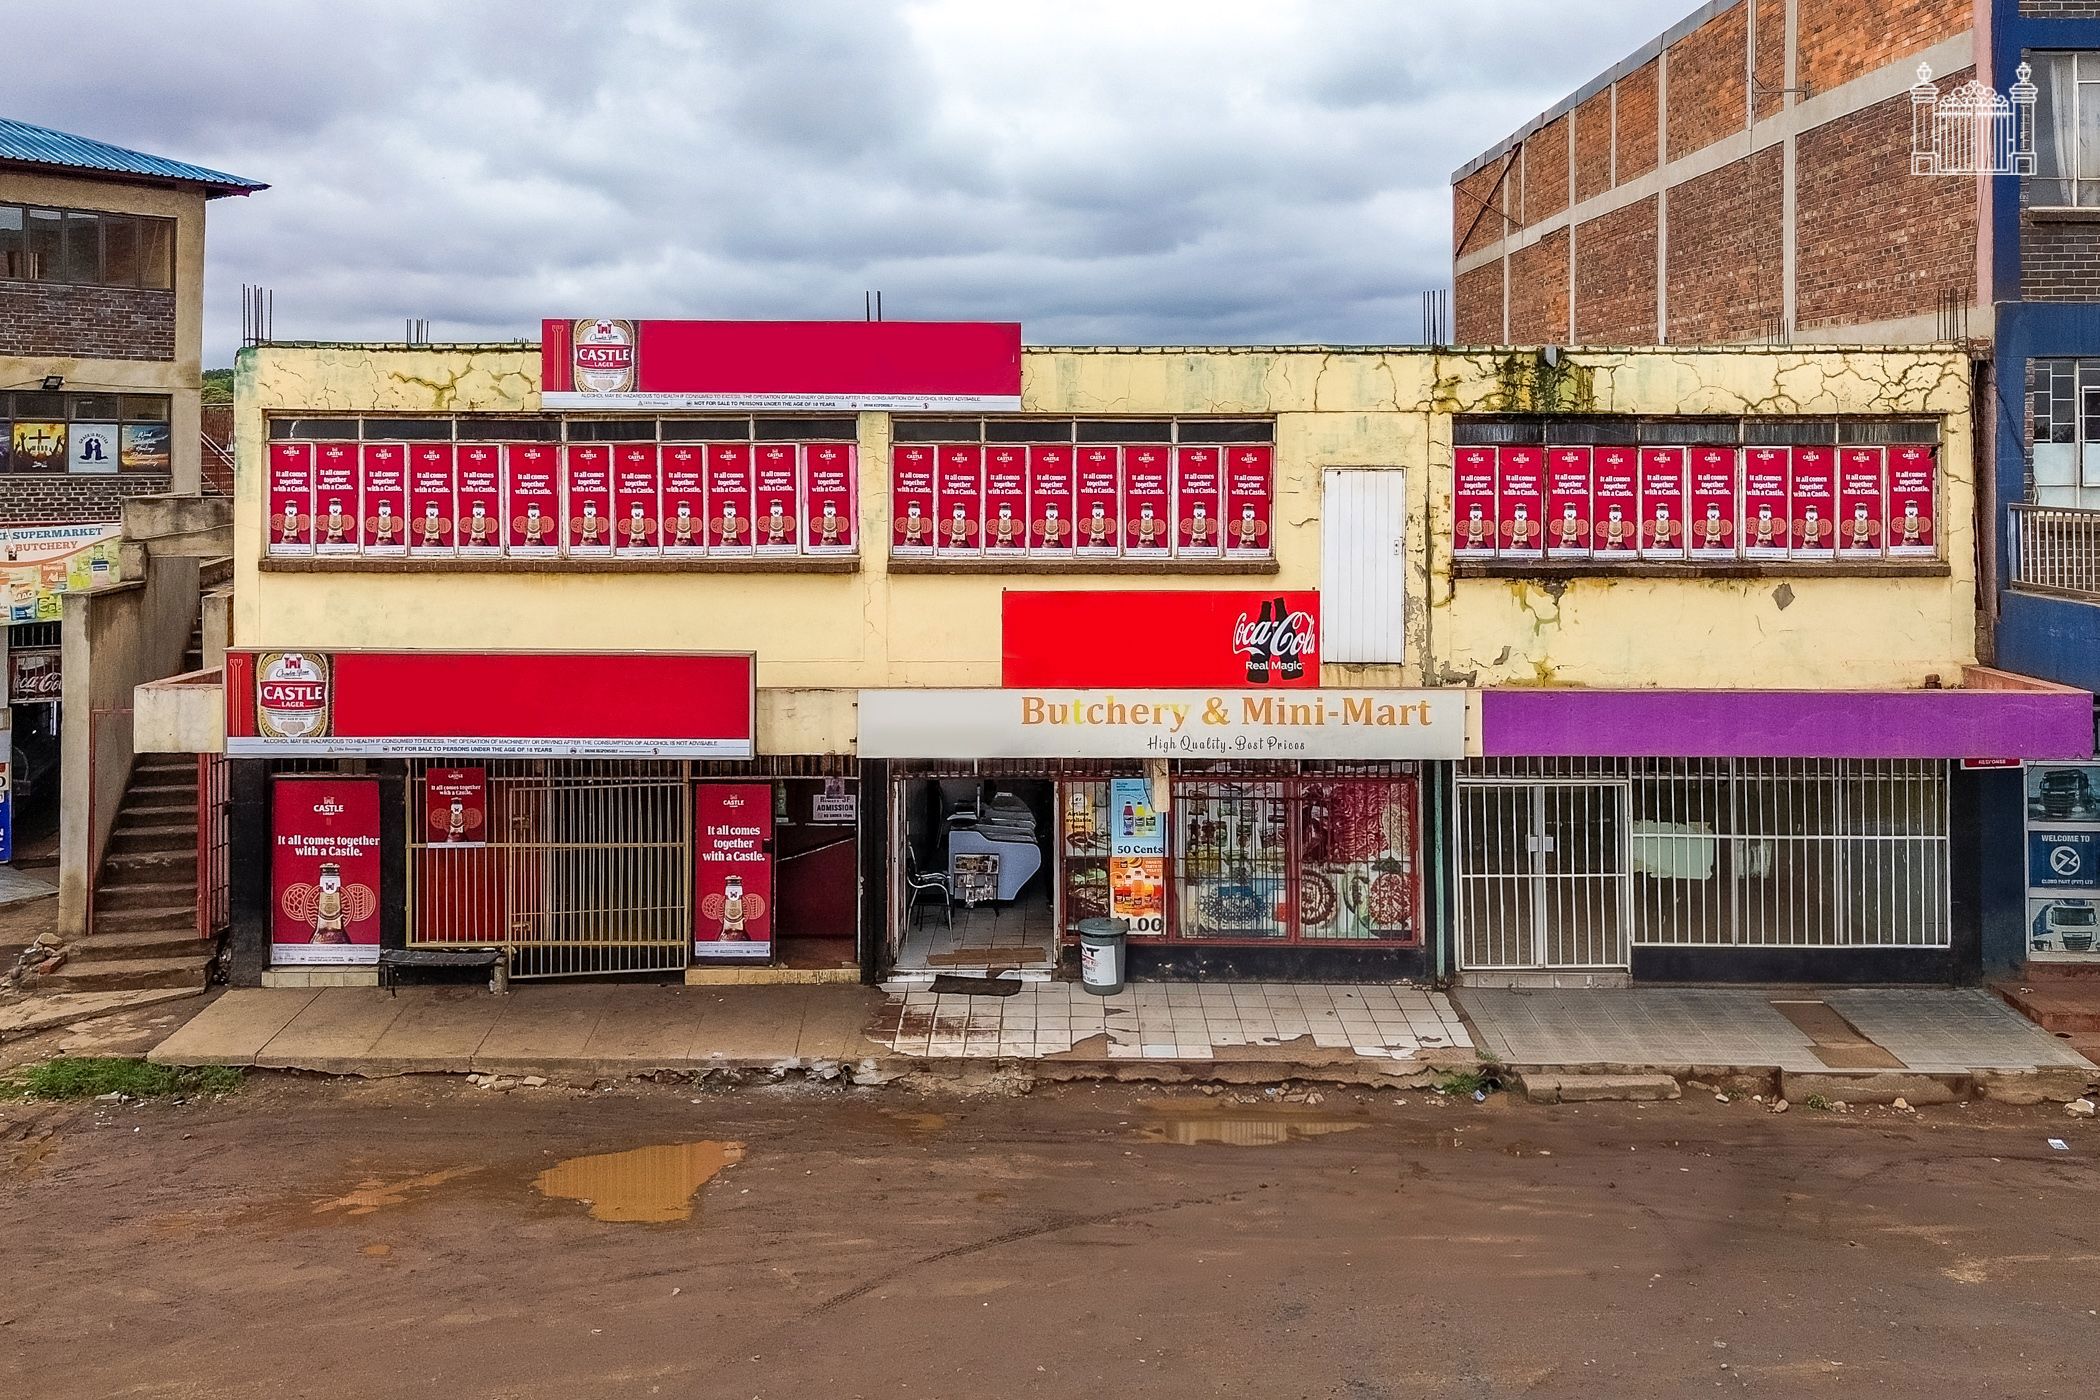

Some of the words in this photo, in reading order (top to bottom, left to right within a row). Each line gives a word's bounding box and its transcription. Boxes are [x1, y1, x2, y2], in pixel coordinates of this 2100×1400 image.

[579, 349, 630, 361] CASTLE
[12, 528, 103, 540] SUPERMARKET
[16, 541, 78, 552] BUTCHERY
[1232, 612, 1315, 656] Coca-Cola
[1246, 661, 1269, 670] Real
[1271, 661, 1302, 672] Magic
[263, 686, 322, 700] CASTLE
[1020, 696, 1190, 732] Butchery
[1202, 697, 1230, 726] &
[1242, 697, 1432, 726] Mini-Mart
[1148, 736, 1176, 753] High
[707, 826, 715, 835] It
[716, 825, 729, 835] all
[730, 827, 760, 835] comes
[278, 835, 285, 845] It
[288, 835, 301, 845] all
[304, 837, 334, 845] comes
[337, 835, 380, 847] together
[714, 838, 754, 850] together
[295, 846, 318, 856] with
[320, 848, 326, 856] a
[329, 846, 363, 856] Castle.
[702, 851, 724, 861] with
[726, 853, 732, 861] a
[733, 851, 765, 861] Castle.
[1118, 846, 1131, 854] 50
[1134, 846, 1163, 854] Cents
